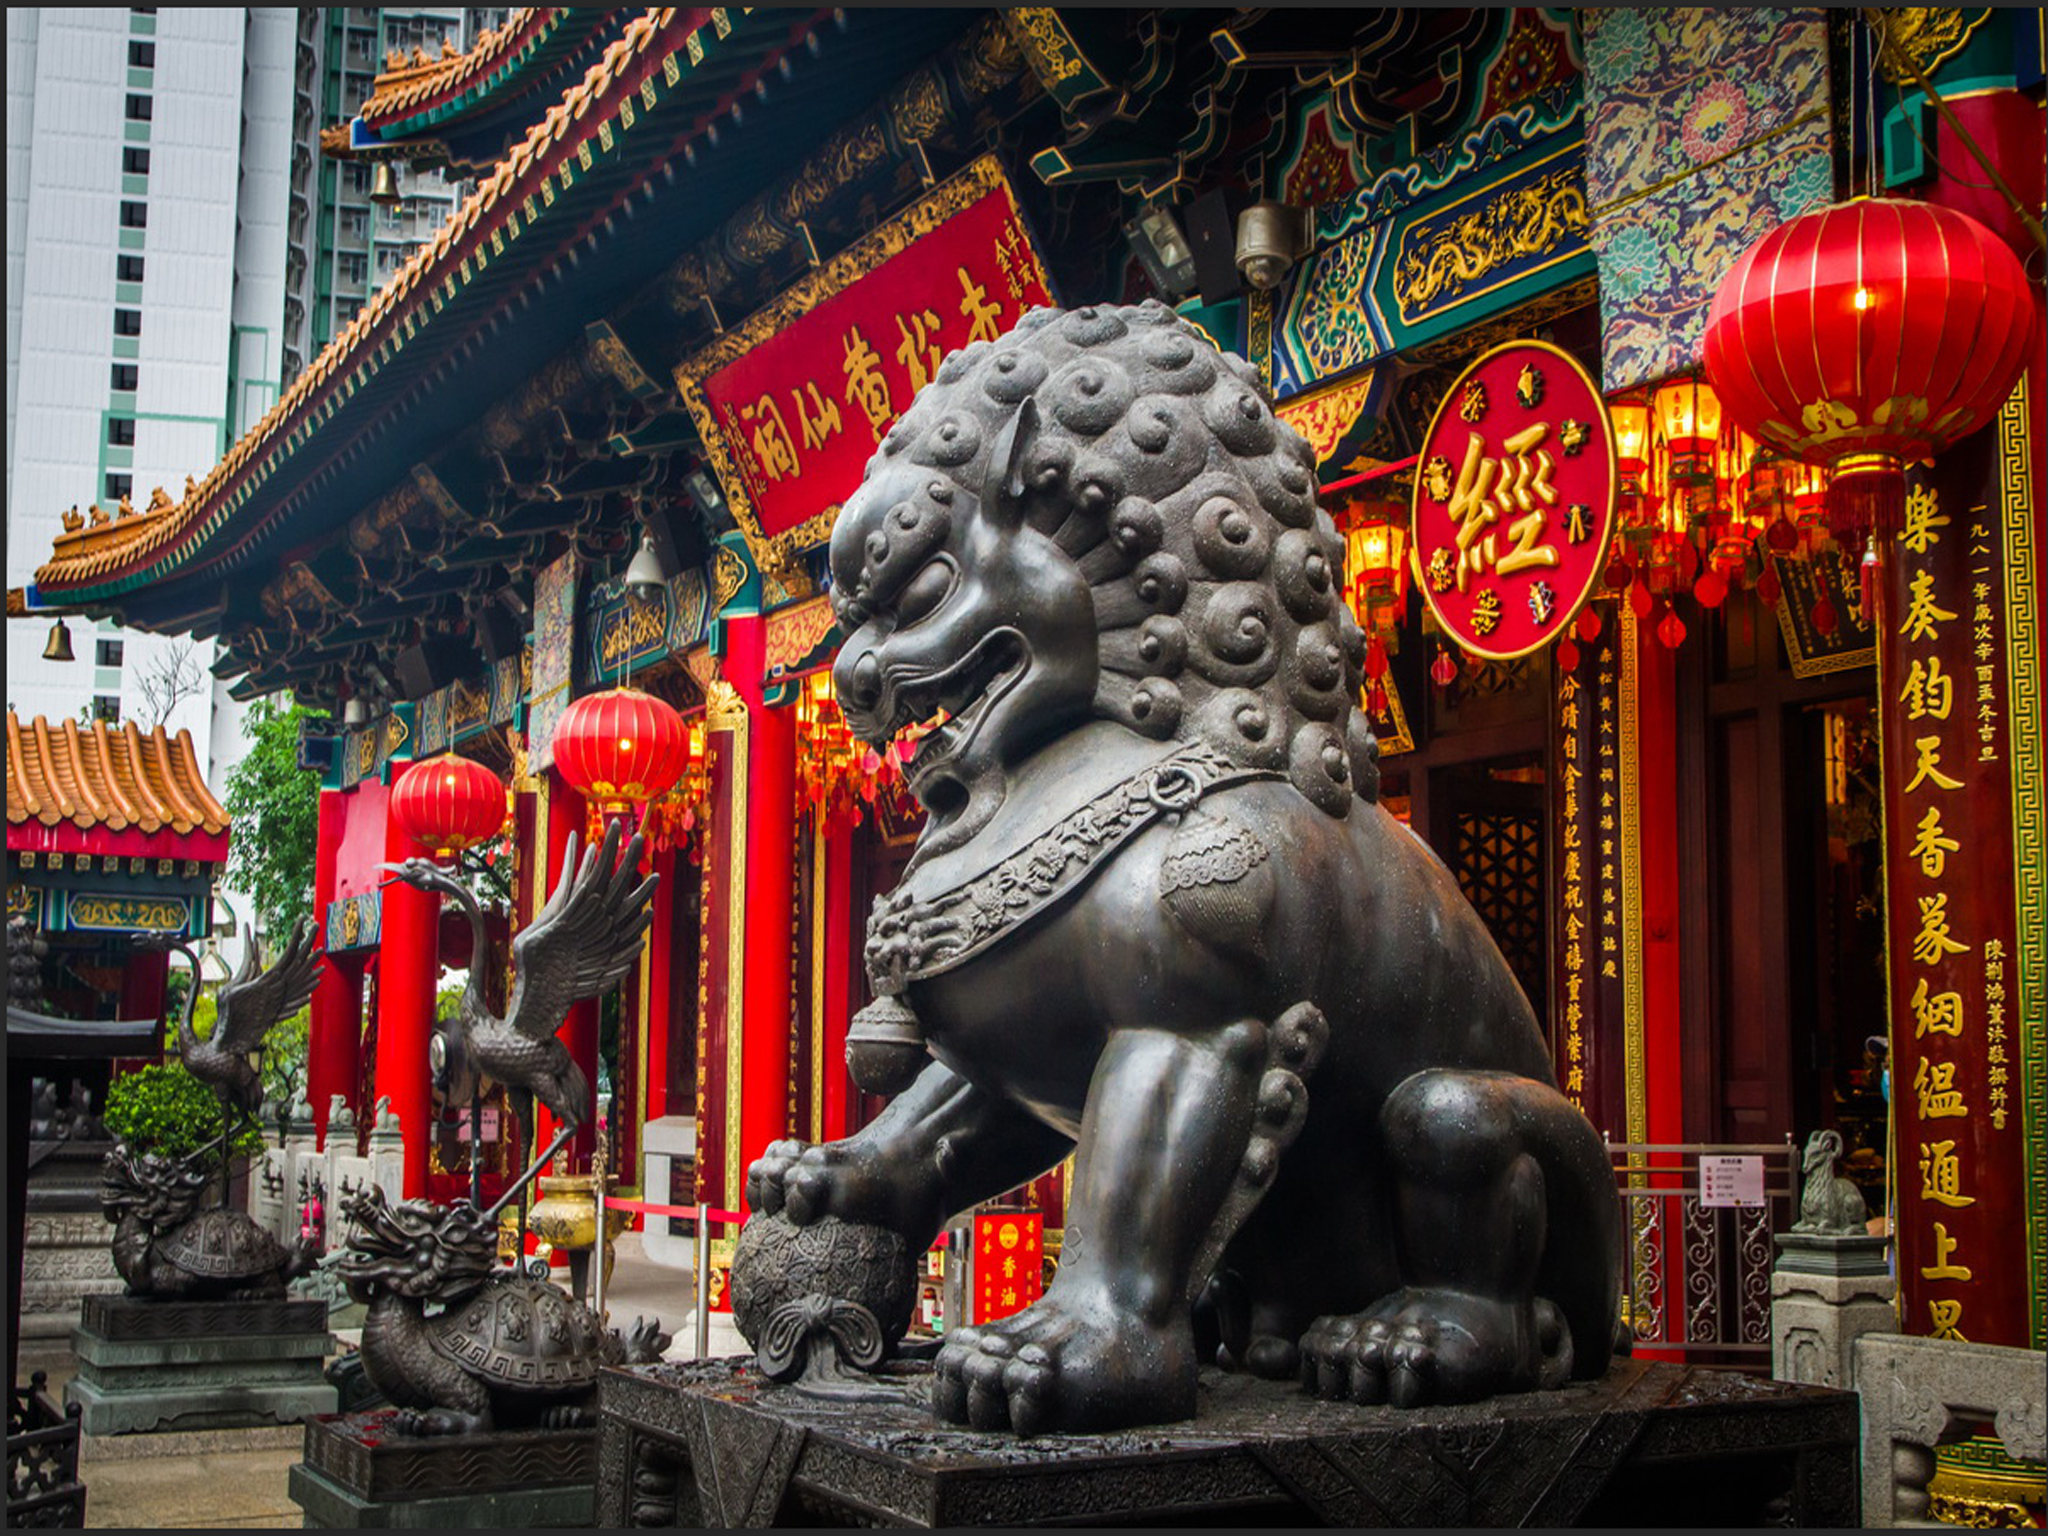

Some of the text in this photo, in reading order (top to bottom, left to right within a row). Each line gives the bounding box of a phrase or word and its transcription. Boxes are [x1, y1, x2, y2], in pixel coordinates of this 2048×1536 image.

[1448, 421, 1559, 593] 經
[1896, 457, 1976, 1344] 樂奏鈞天香篆絪縕通上界
[1001, 1256, 1017, 1307] 香油
